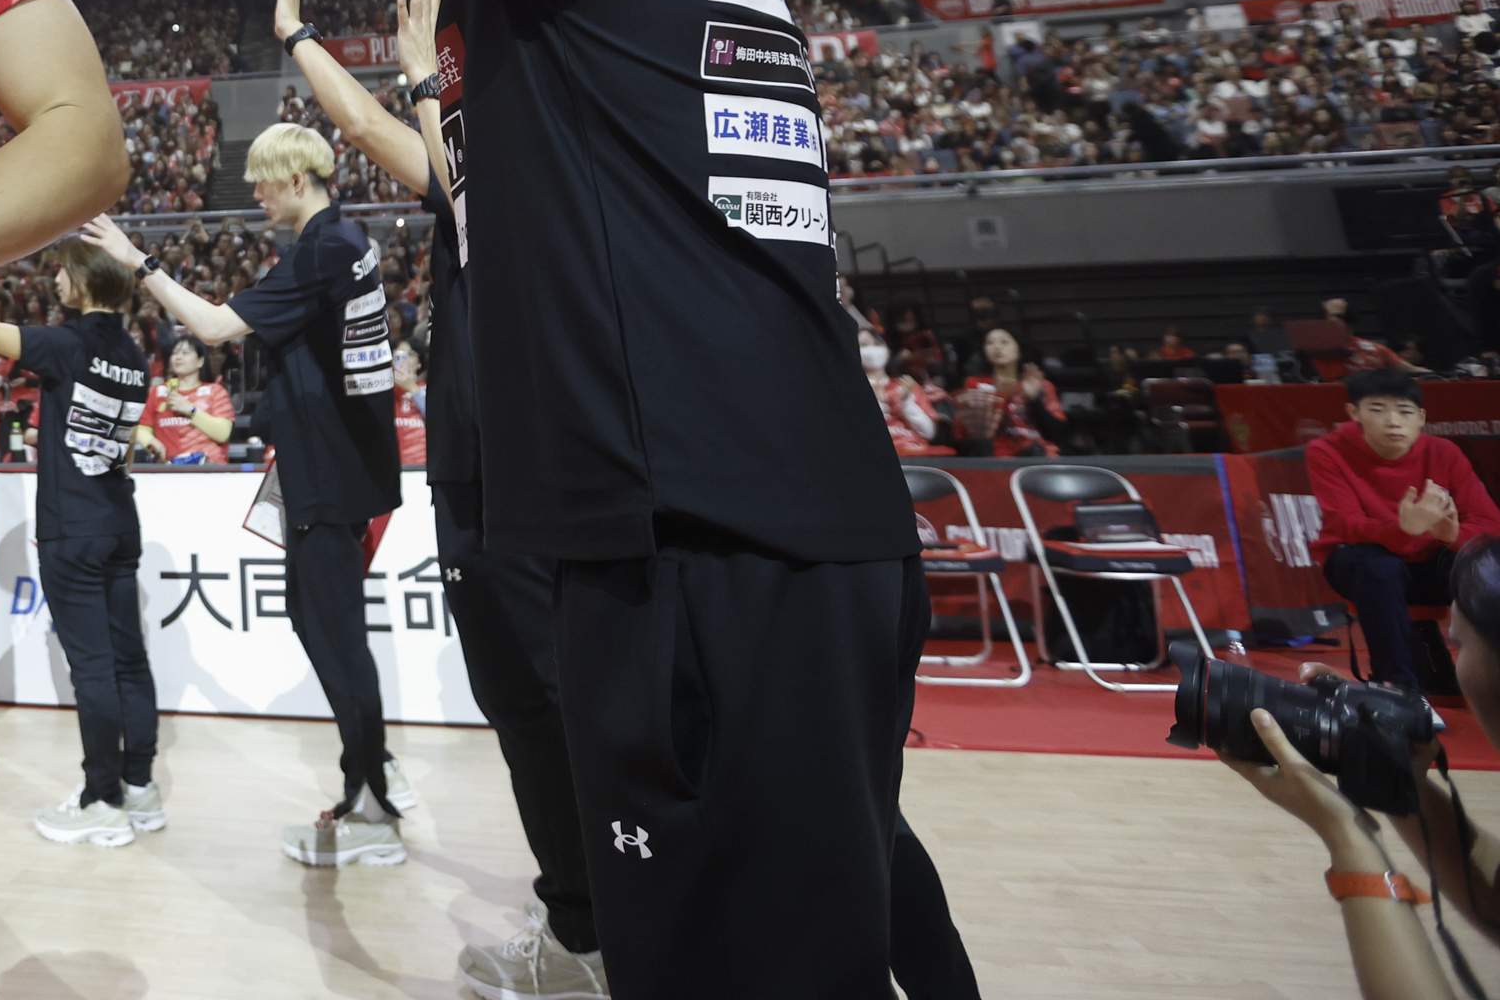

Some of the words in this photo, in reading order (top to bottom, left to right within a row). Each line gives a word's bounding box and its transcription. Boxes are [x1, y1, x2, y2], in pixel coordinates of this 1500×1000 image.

[745, 202, 827, 232] 関西クリーン
